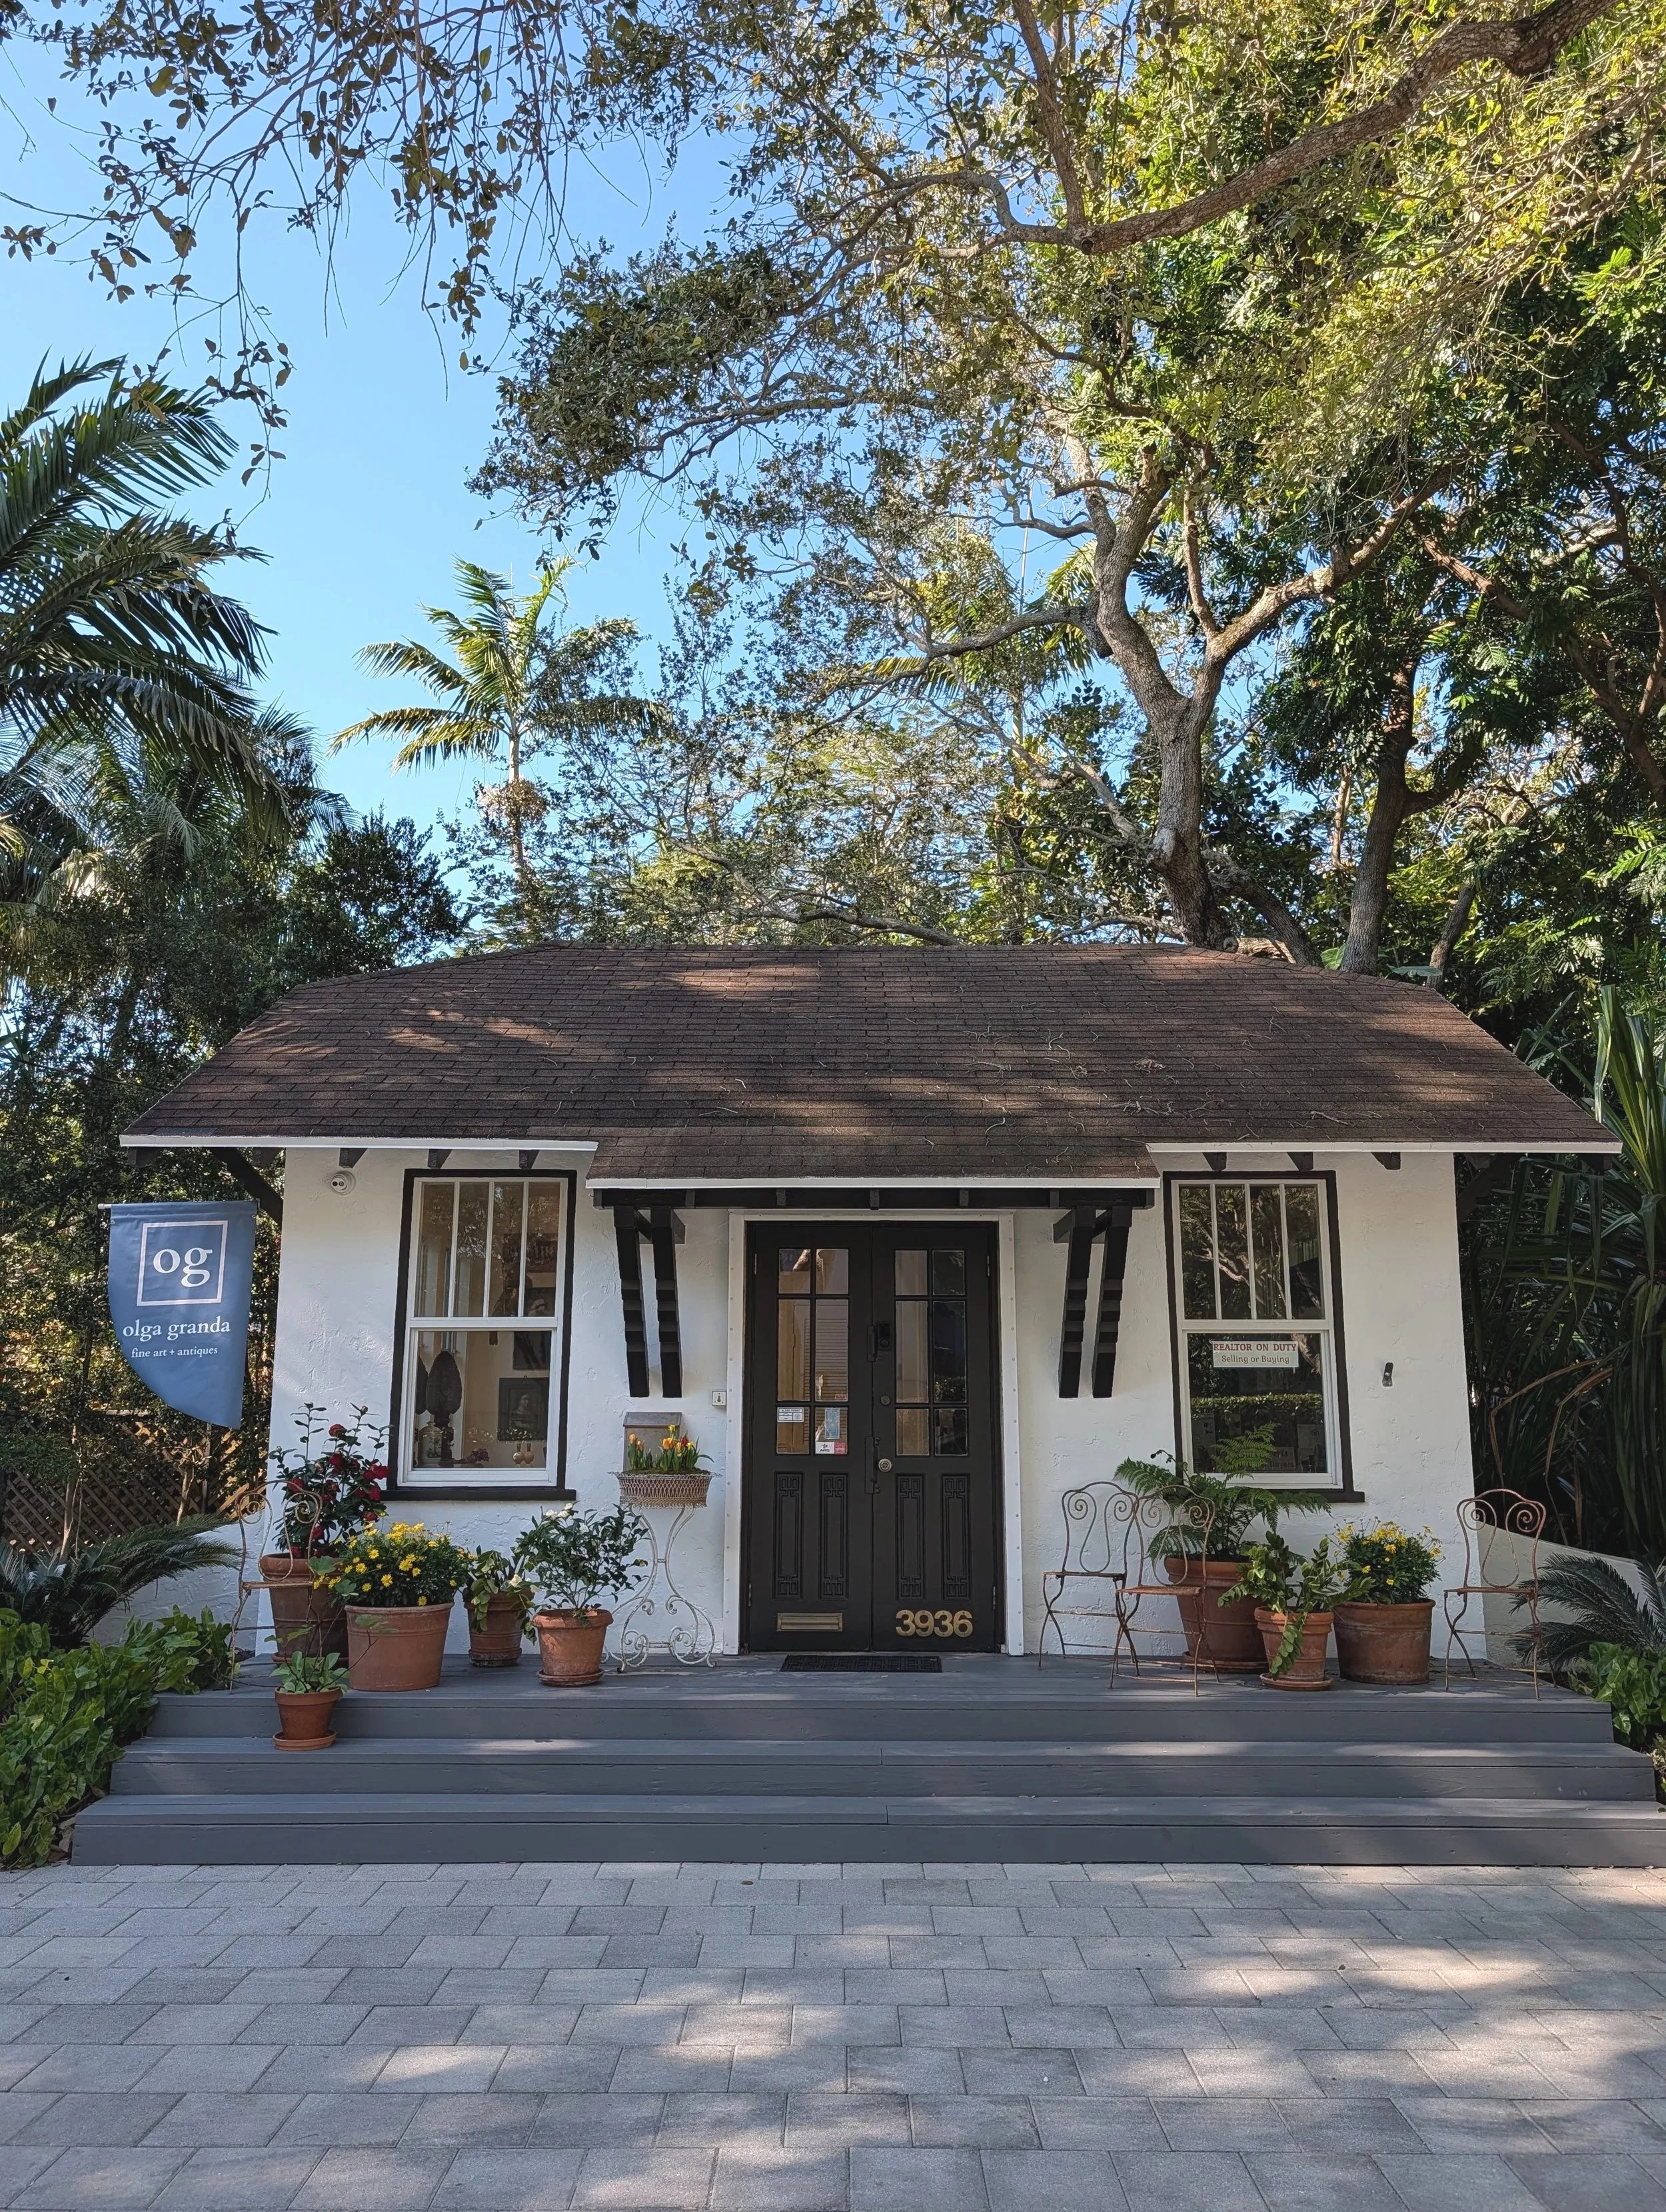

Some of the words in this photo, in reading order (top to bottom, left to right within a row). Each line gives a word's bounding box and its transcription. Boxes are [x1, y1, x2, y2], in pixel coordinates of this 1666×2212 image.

[153, 1247, 213, 1288] og
[123, 1319, 162, 1342] olga
[167, 1315, 231, 1341] granda
[131, 1348, 151, 1358] fine
[177, 1346, 218, 1358] antiques
[1213, 1343, 1253, 1352] REALTOR
[1256, 1343, 1269, 1352] ON
[1222, 1355, 1248, 1364] Selling
[1261, 1355, 1289, 1365] Buying
[895, 1610, 973, 1638] 3936
